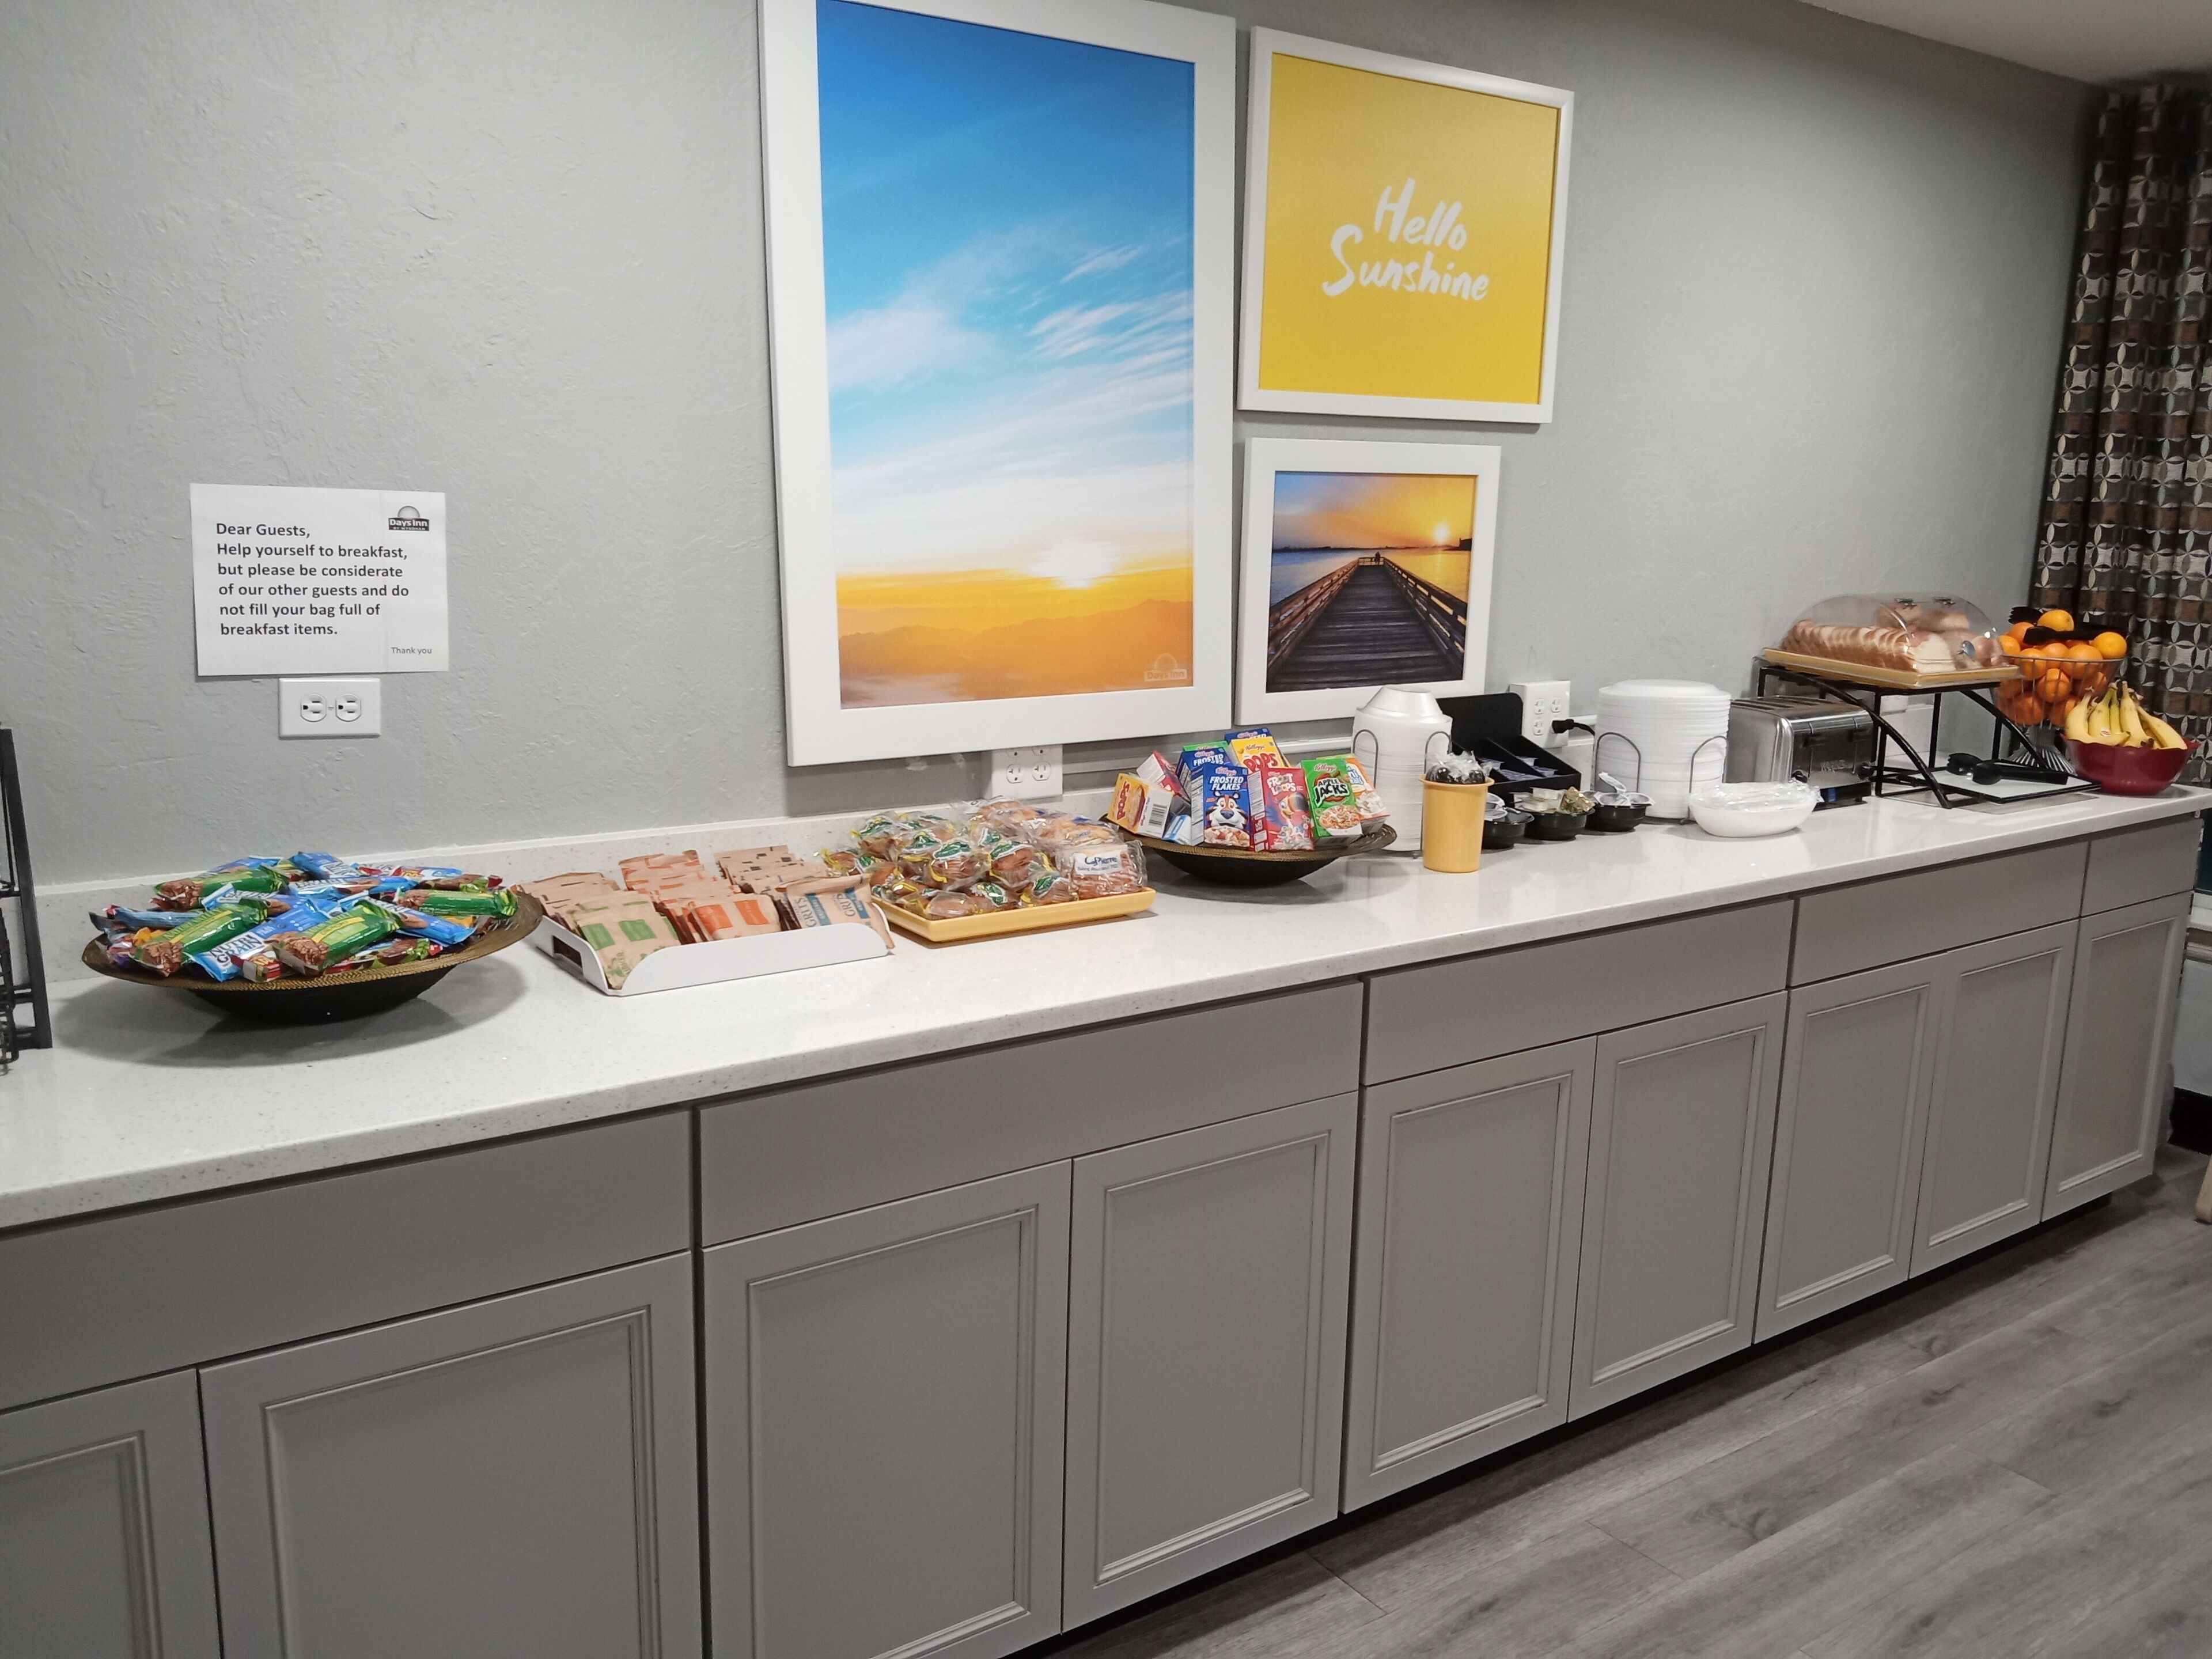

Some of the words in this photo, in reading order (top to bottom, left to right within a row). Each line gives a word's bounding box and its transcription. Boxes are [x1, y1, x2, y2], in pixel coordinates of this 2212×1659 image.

[1374, 177, 1467, 250] Hello
[1322, 224, 1490, 301] Sunshine
[216, 522, 252, 535] Dear
[256, 524, 310, 539] Guests,
[217, 543, 251, 558] Help
[255, 544, 315, 558] yourself
[318, 546, 334, 557] to
[338, 544, 407, 560] breakfast,
[217, 562, 244, 575] but
[248, 563, 295, 578] please
[300, 563, 317, 577] be
[321, 565, 403, 577] considerate
[218, 583, 234, 595] of
[238, 586, 264, 596] our
[268, 583, 308, 596] other
[312, 585, 358, 599] guests
[361, 584, 387, 596] and
[391, 584, 409, 597] do
[219, 604, 245, 615] not
[248, 603, 268, 615] fill
[271, 606, 306, 618] your
[309, 603, 335, 618] bag
[339, 603, 362, 615] full
[366, 603, 381, 615] of
[220, 623, 290, 635] breakfast
[294, 623, 338, 635] items.
[1193, 753, 1224, 766] FROSTED
[1243, 753, 1279, 773] POPS
[1210, 776, 1244, 784] FROSTED
[1212, 783, 1241, 791] FLAKES
[1267, 773, 1294, 789] FROOT
[1271, 782, 1297, 796] LOOPS
[1315, 783, 1349, 803] JACKS
[1116, 781, 1131, 821] POPS
[796, 897, 817, 927] GRITS
[210, 934, 253, 958] NUTRI
[217, 937, 263, 964] GRAIN
